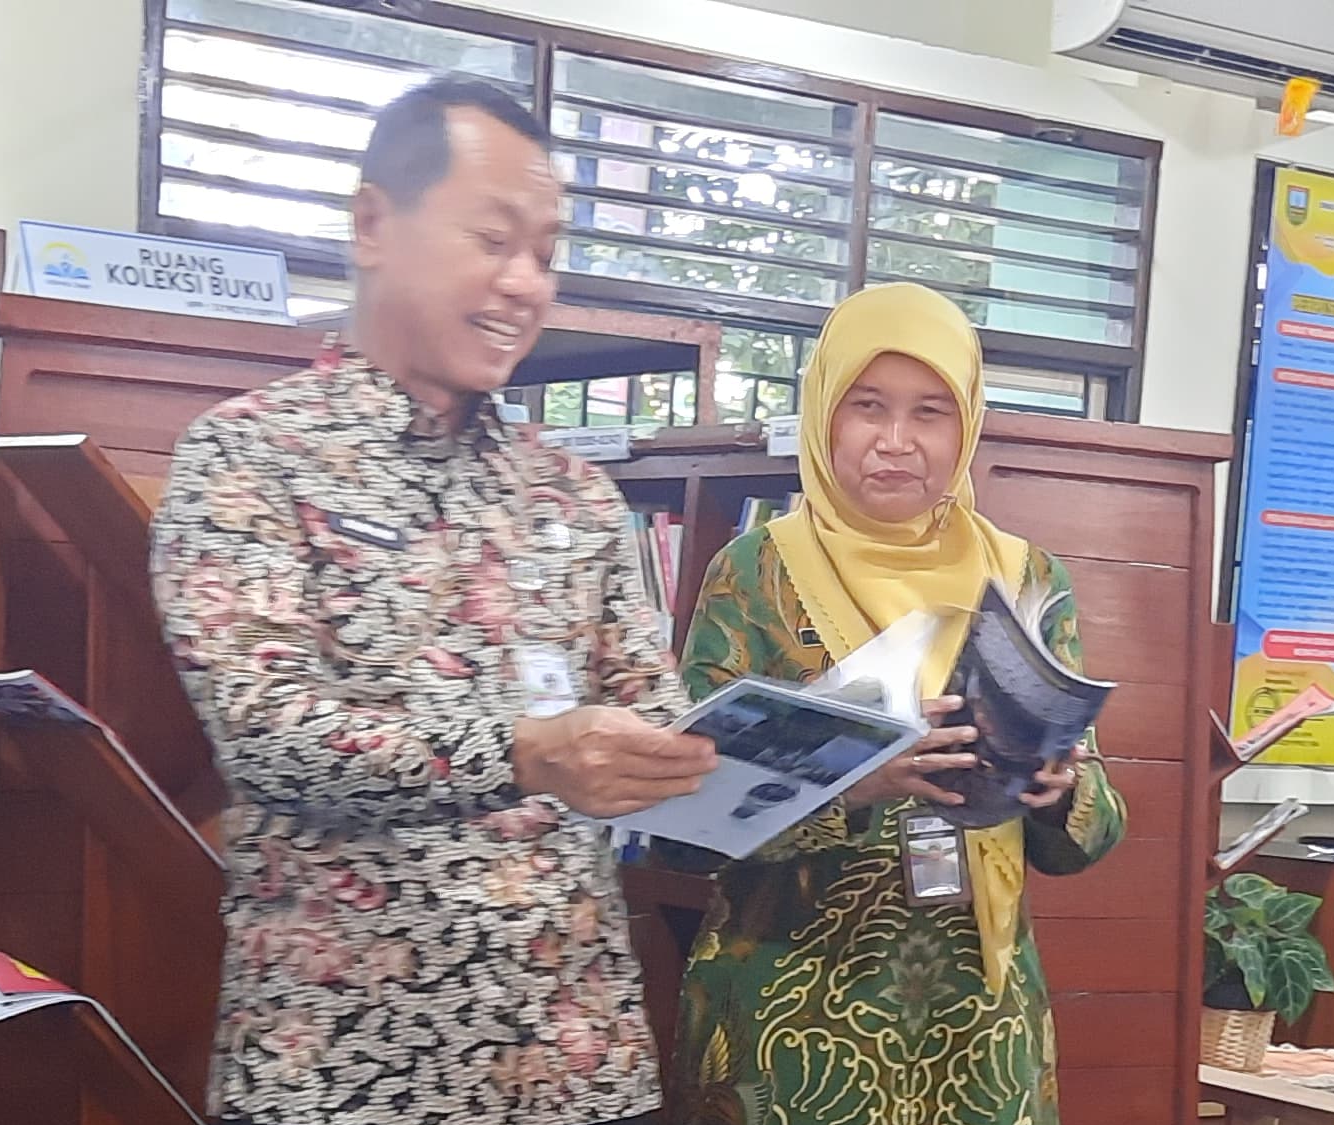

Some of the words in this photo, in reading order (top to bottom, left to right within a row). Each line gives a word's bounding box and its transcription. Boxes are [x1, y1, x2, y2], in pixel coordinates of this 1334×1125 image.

[139, 248, 224, 275] RUANG
[105, 263, 204, 294] KOLEKSI
[209, 276, 274, 302] BUKU
